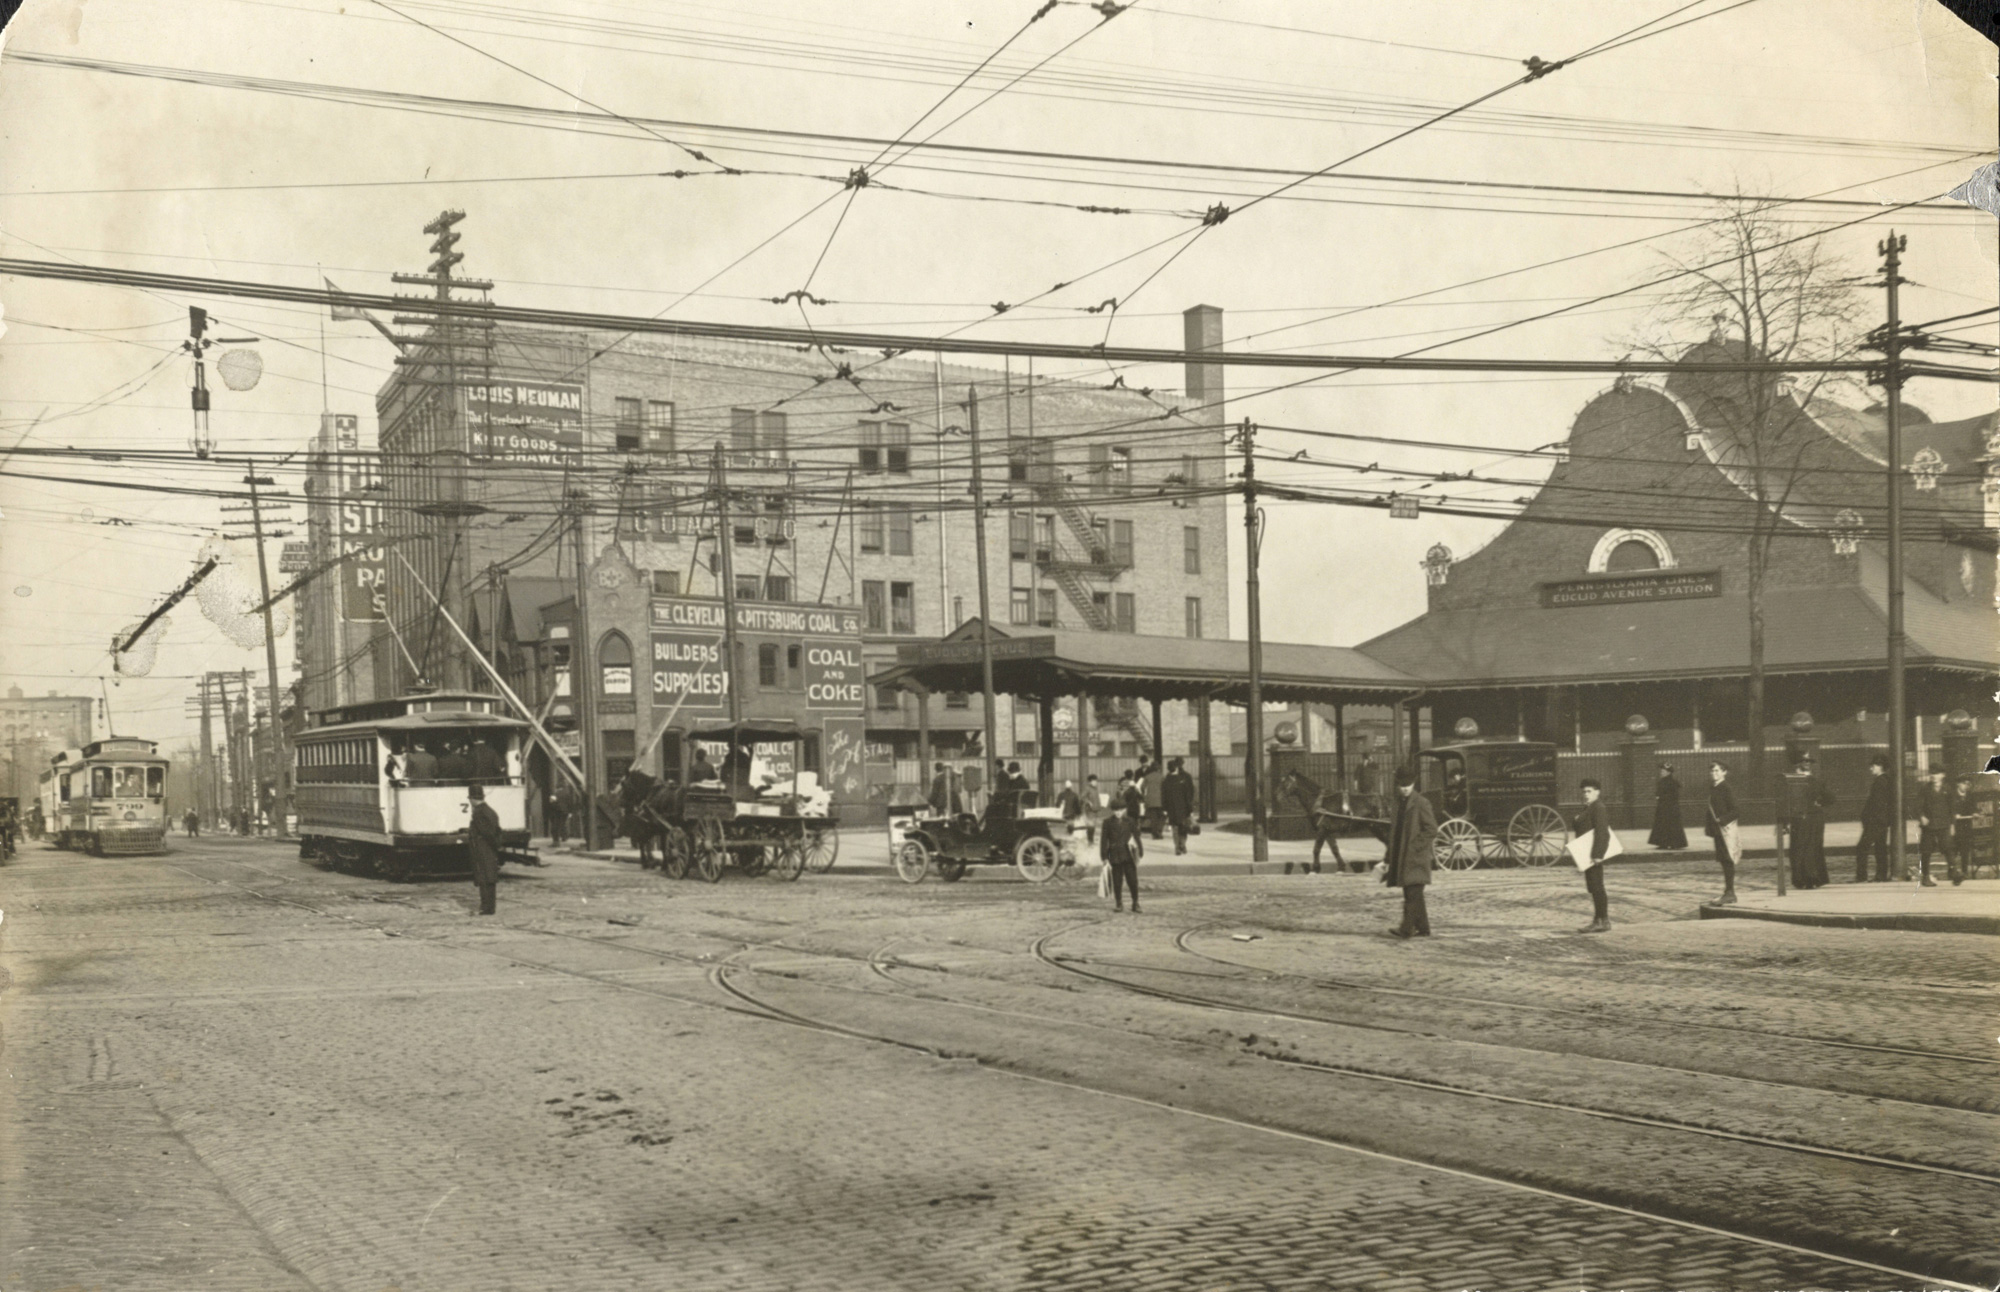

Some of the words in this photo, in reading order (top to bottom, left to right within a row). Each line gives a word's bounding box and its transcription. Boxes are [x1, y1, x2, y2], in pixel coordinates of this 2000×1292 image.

[468, 386, 513, 404] LOUIS
[517, 386, 580, 410] NEUMAN
[337, 417, 356, 450] THE
[510, 435, 557, 451] GOODS
[1553, 592, 1597, 604] EUCLID
[1602, 588, 1653, 600] AVENUE
[1658, 583, 1714, 596] STATION
[1557, 578, 1658, 592] PENNSYLVANIA
[1665, 576, 1707, 585] LINES
[654, 607, 672, 620] THE
[673, 605, 726, 627] CLEVELAN
[745, 614, 806, 631] PITTSBURG
[809, 614, 840, 633] COAL
[654, 642, 719, 662] BUILDERS
[808, 648, 860, 667] COAL
[976, 642, 1027, 655] AENUE
[653, 671, 722, 694] SUPPLIES
[823, 670, 845, 680] AND
[808, 684, 862, 701] COKE
[756, 743, 780, 755] COAL
